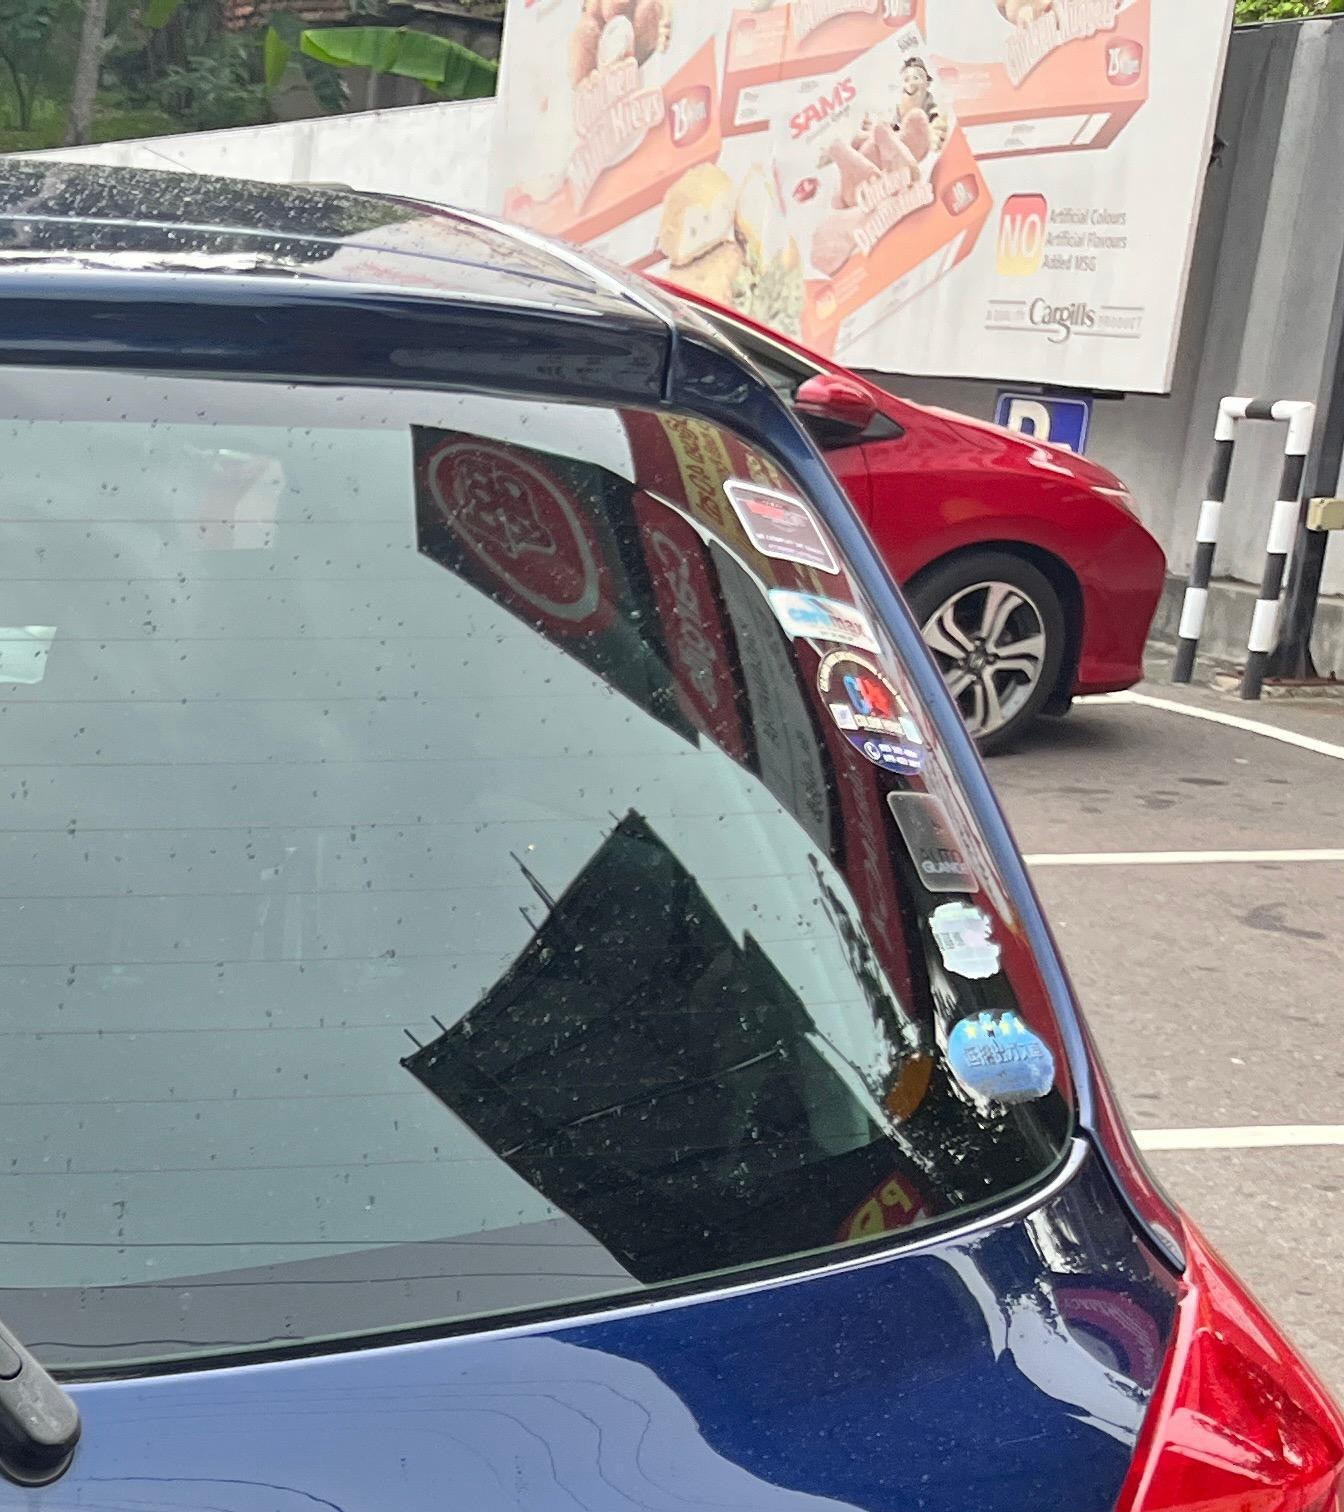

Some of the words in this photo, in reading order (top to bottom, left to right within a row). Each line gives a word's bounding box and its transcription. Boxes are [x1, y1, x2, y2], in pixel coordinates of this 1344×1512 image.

[1050, 207, 1089, 224] Artificial
[1091, 209, 1127, 226] Colours
[1000, 213, 1042, 257] NO
[1046, 231, 1085, 248] Artificial
[1087, 232, 1128, 249] Flavours
[1042, 255, 1072, 270] Added
[1075, 256, 1097, 271] MSG
[1029, 297, 1096, 344] Cargills
